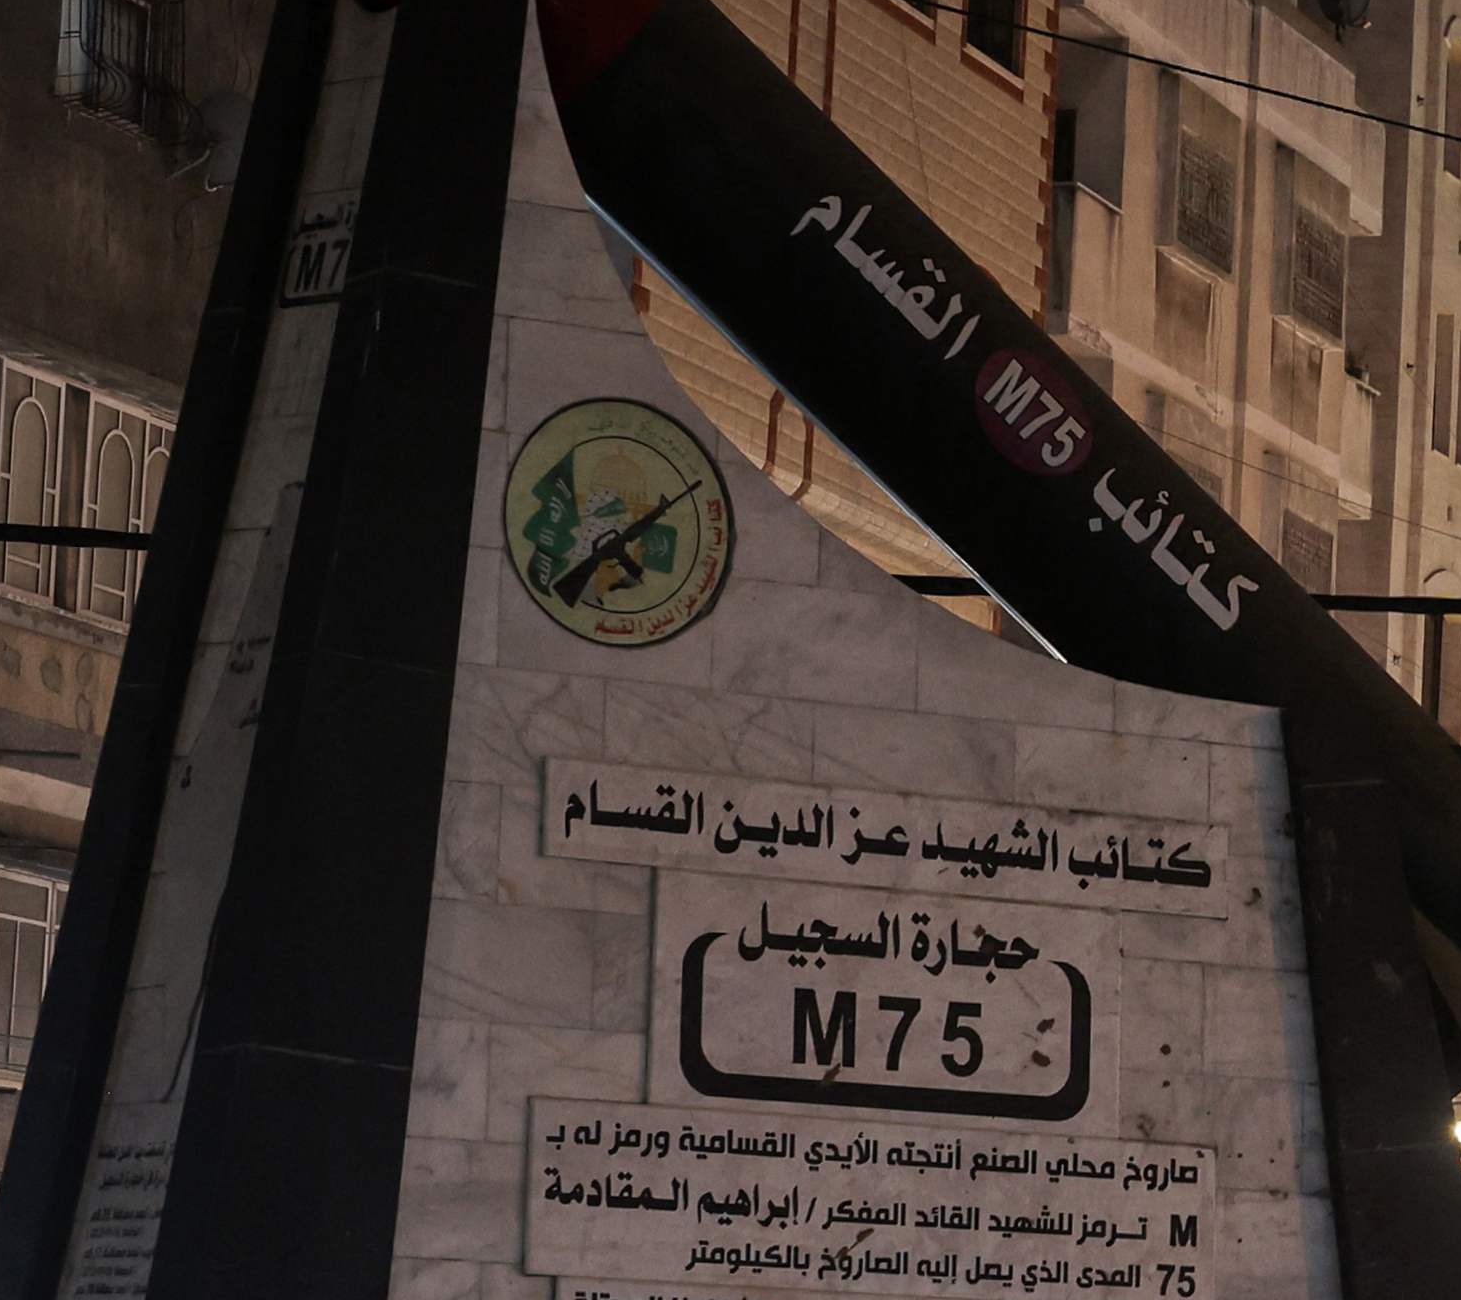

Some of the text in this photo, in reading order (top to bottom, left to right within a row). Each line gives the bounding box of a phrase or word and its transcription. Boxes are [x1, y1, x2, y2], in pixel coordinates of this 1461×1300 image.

[790, 194, 1259, 630] كتائب M75 القسام
[565, 780, 1210, 889] كتائب الشهيد عز الدين القسام
[739, 901, 1039, 983] حجارة السجيل
[574, 1120, 601, 1145] له
[609, 1123, 670, 1158] ورمز
[679, 1127, 795, 1158] القسامية
[805, 1132, 878, 1171] الأيدي
[971, 1147, 1037, 1180] الصنع
[1046, 1154, 1115, 1182] محلي
[544, 1167, 688, 1211] المقادمة
[1123, 1156, 1198, 1190] صاروخ
[697, 1184, 798, 1229] إبراهيم
[822, 1203, 905, 1229] المفكر
[915, 1206, 979, 1230] القائد
[988, 1205, 1072, 1238] للشهيد
[1170, 1214, 1197, 1247] M
[686, 1240, 1195, 1297] 75 المدى الذي يصل إليه الصاروخ بالكيلومتر
